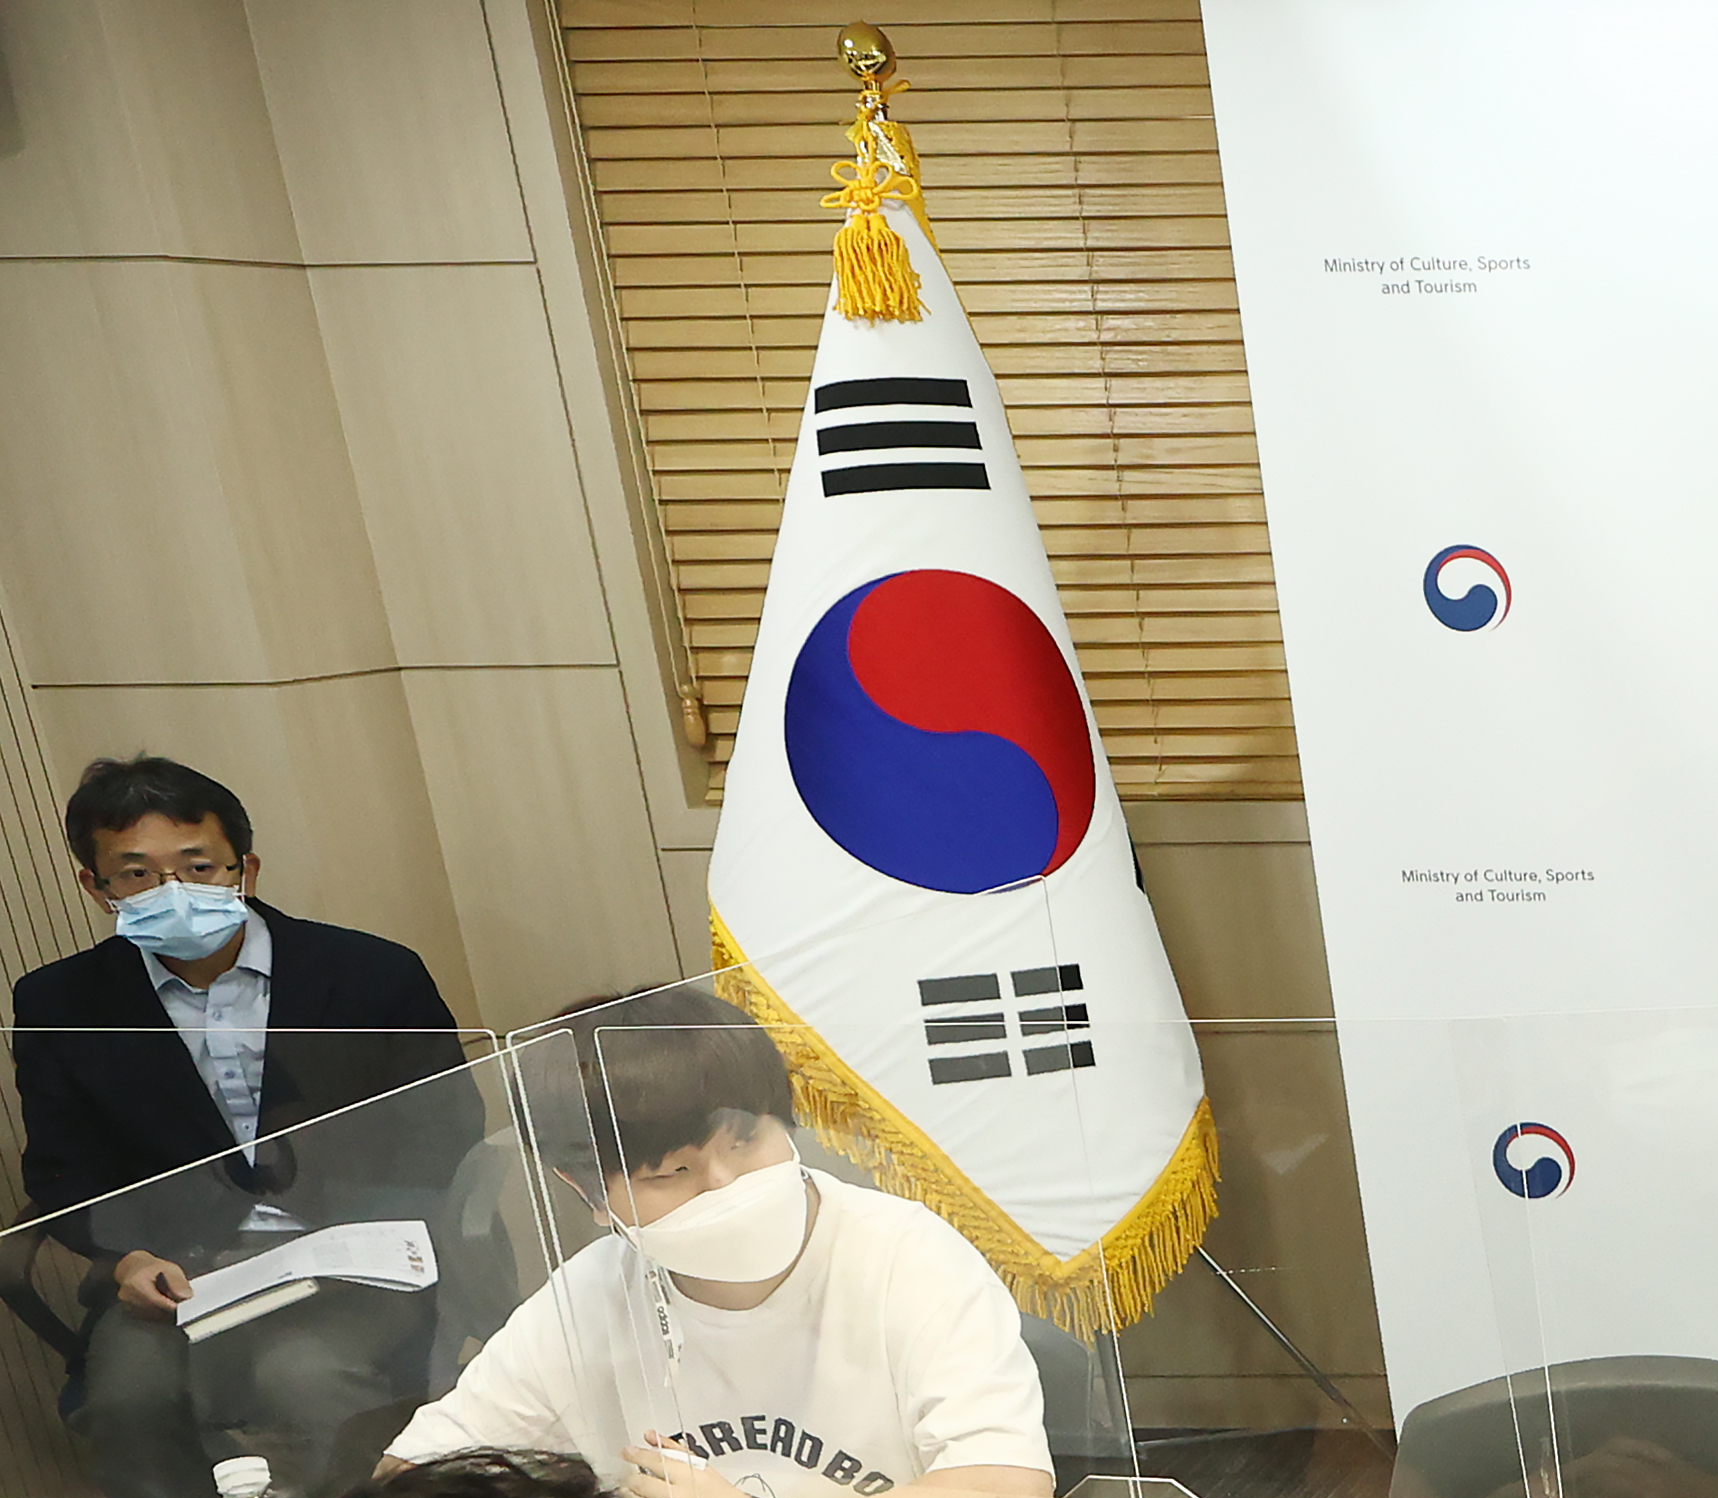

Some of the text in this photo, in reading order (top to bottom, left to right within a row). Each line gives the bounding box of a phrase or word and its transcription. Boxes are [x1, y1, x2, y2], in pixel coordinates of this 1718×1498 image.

[1323, 255, 1531, 275] Ministry of Culture, Sports
[1381, 279, 1478, 295] and Tourism
[1401, 868, 1595, 886] Ministry of Culture, Sports
[1455, 888, 1547, 903] and Tourism
